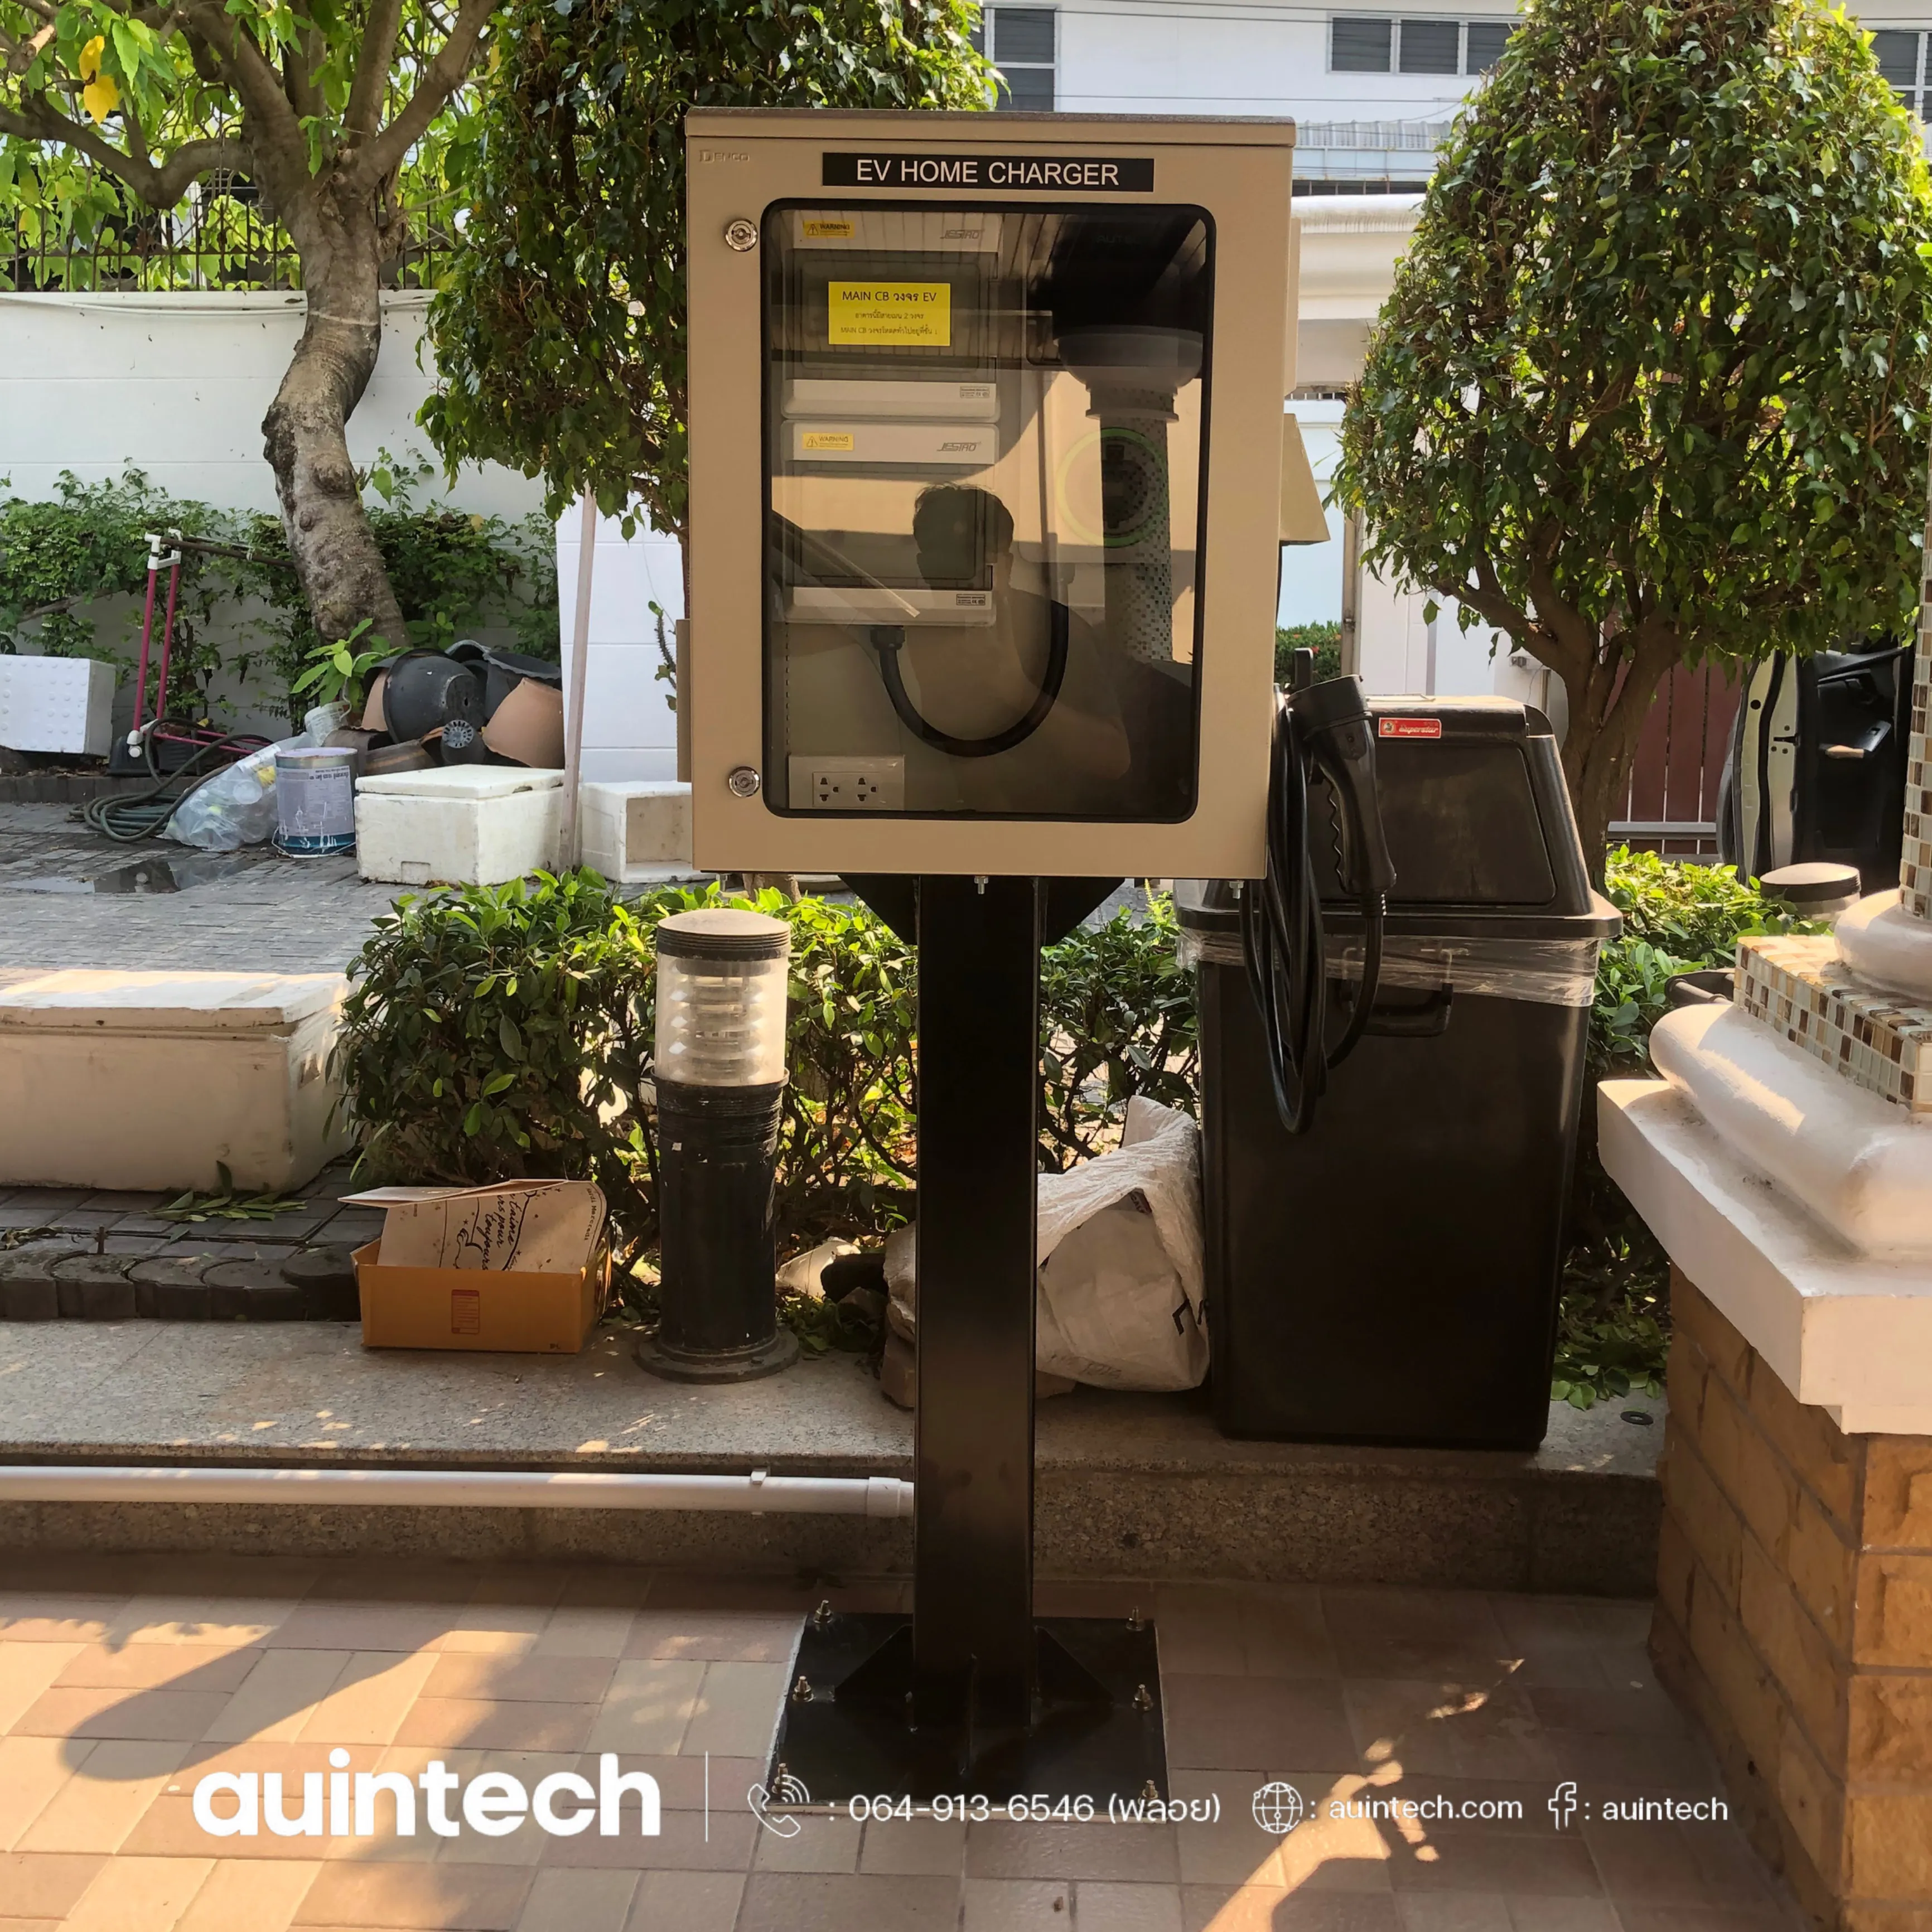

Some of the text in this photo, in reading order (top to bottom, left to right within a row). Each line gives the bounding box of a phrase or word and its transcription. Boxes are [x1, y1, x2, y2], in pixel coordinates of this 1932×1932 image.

[857, 160, 1119, 186] EV HOME CHARGER
[842, 291, 937, 302] MAIN CB วงจร EV
[476, 1213, 498, 1271] toujours
[493, 1211, 506, 1249] pour
